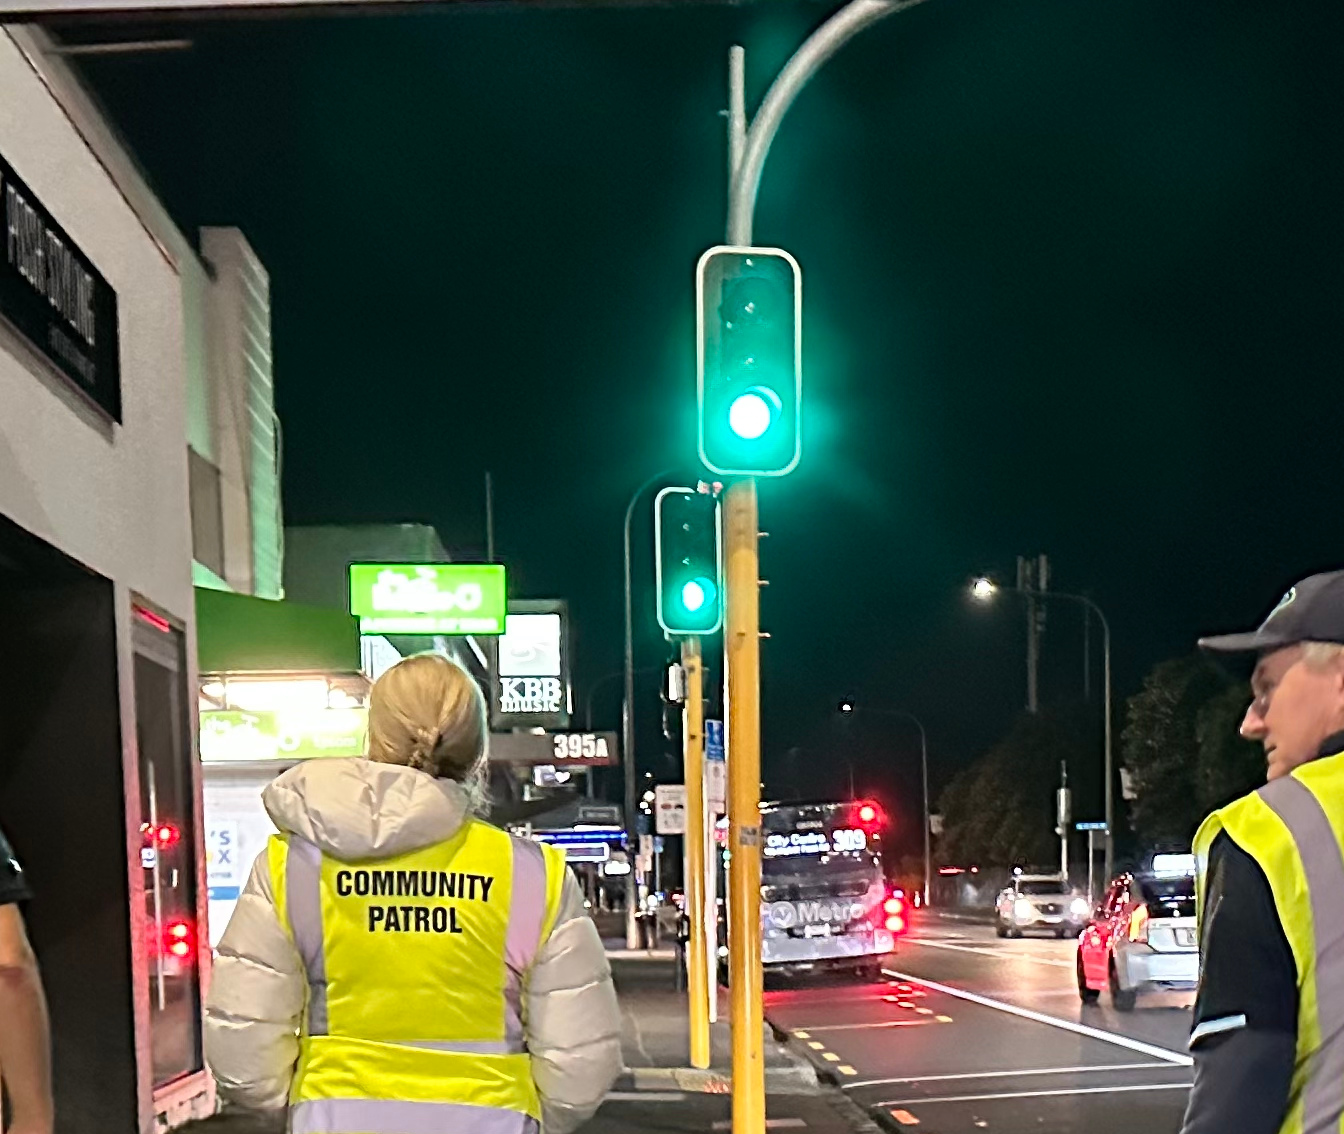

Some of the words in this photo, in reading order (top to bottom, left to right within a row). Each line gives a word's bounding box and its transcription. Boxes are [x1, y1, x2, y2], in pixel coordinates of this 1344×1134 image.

[499, 677, 562, 702] KBB
[500, 697, 560, 713] music
[553, 733, 609, 758] 395A
[336, 870, 495, 902] COMMUNITY
[368, 905, 463, 933] PATROL
[797, 901, 864, 922] Metro
